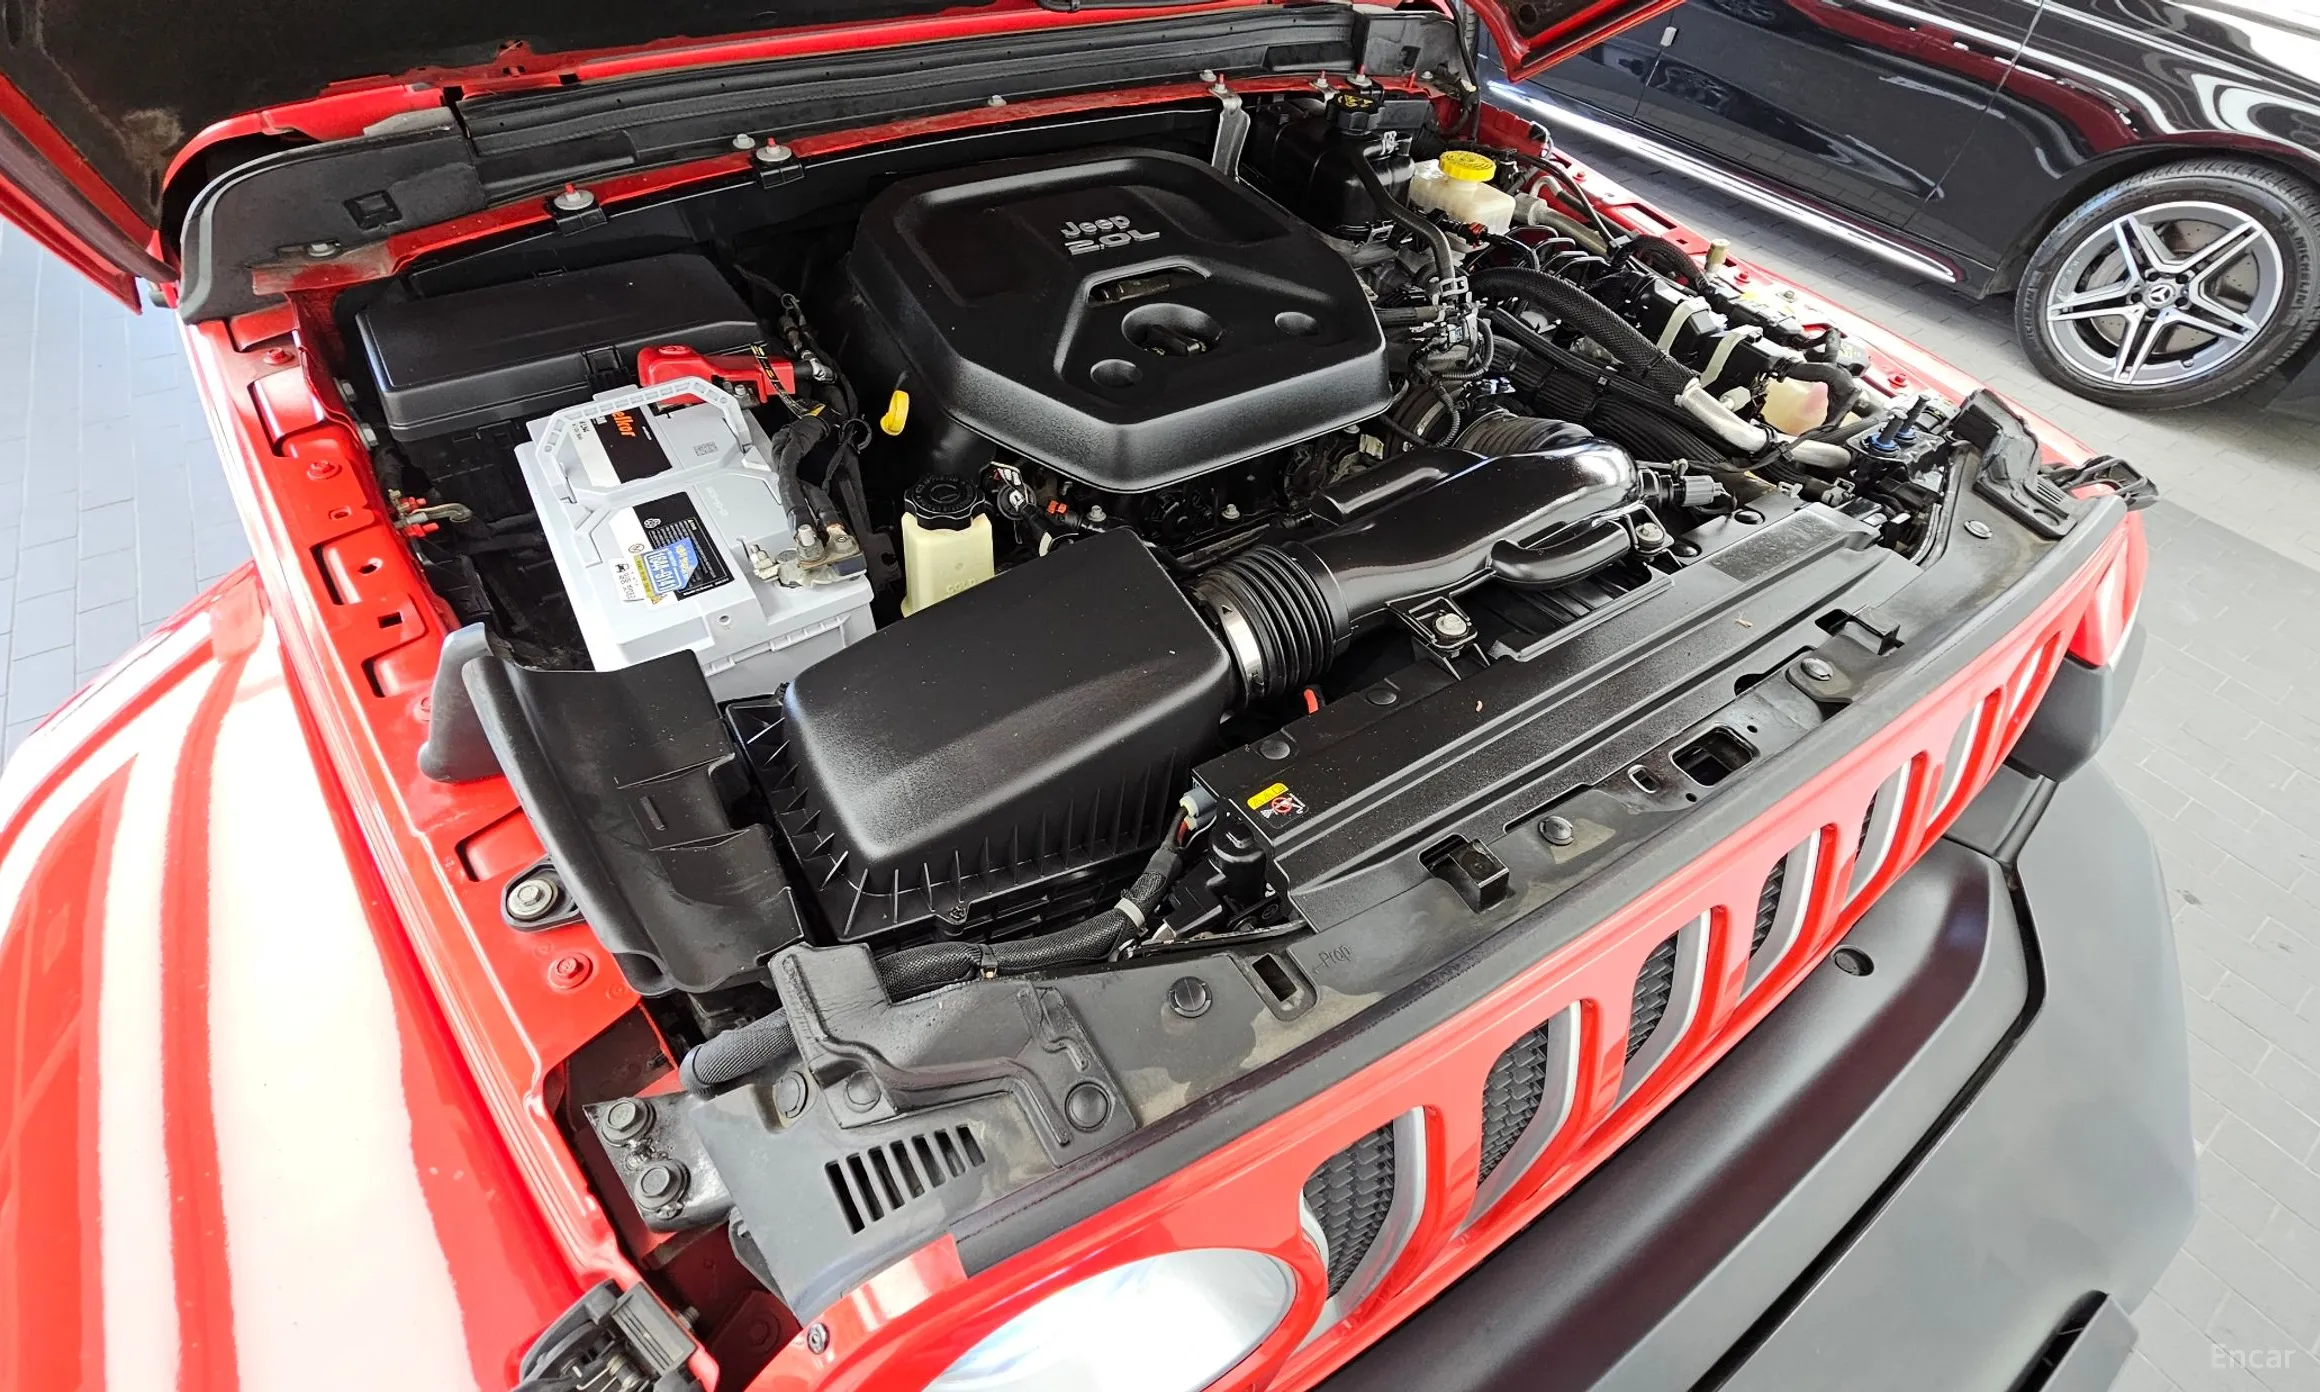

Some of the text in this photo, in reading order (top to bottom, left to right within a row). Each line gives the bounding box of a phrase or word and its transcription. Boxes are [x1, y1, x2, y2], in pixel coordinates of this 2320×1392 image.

[1060, 215, 1130, 237] Jeep
[1065, 230, 1160, 256] 2.0L
[2291, 235, 2311, 309] MICHELIN
[611, 411, 637, 437] elkor
